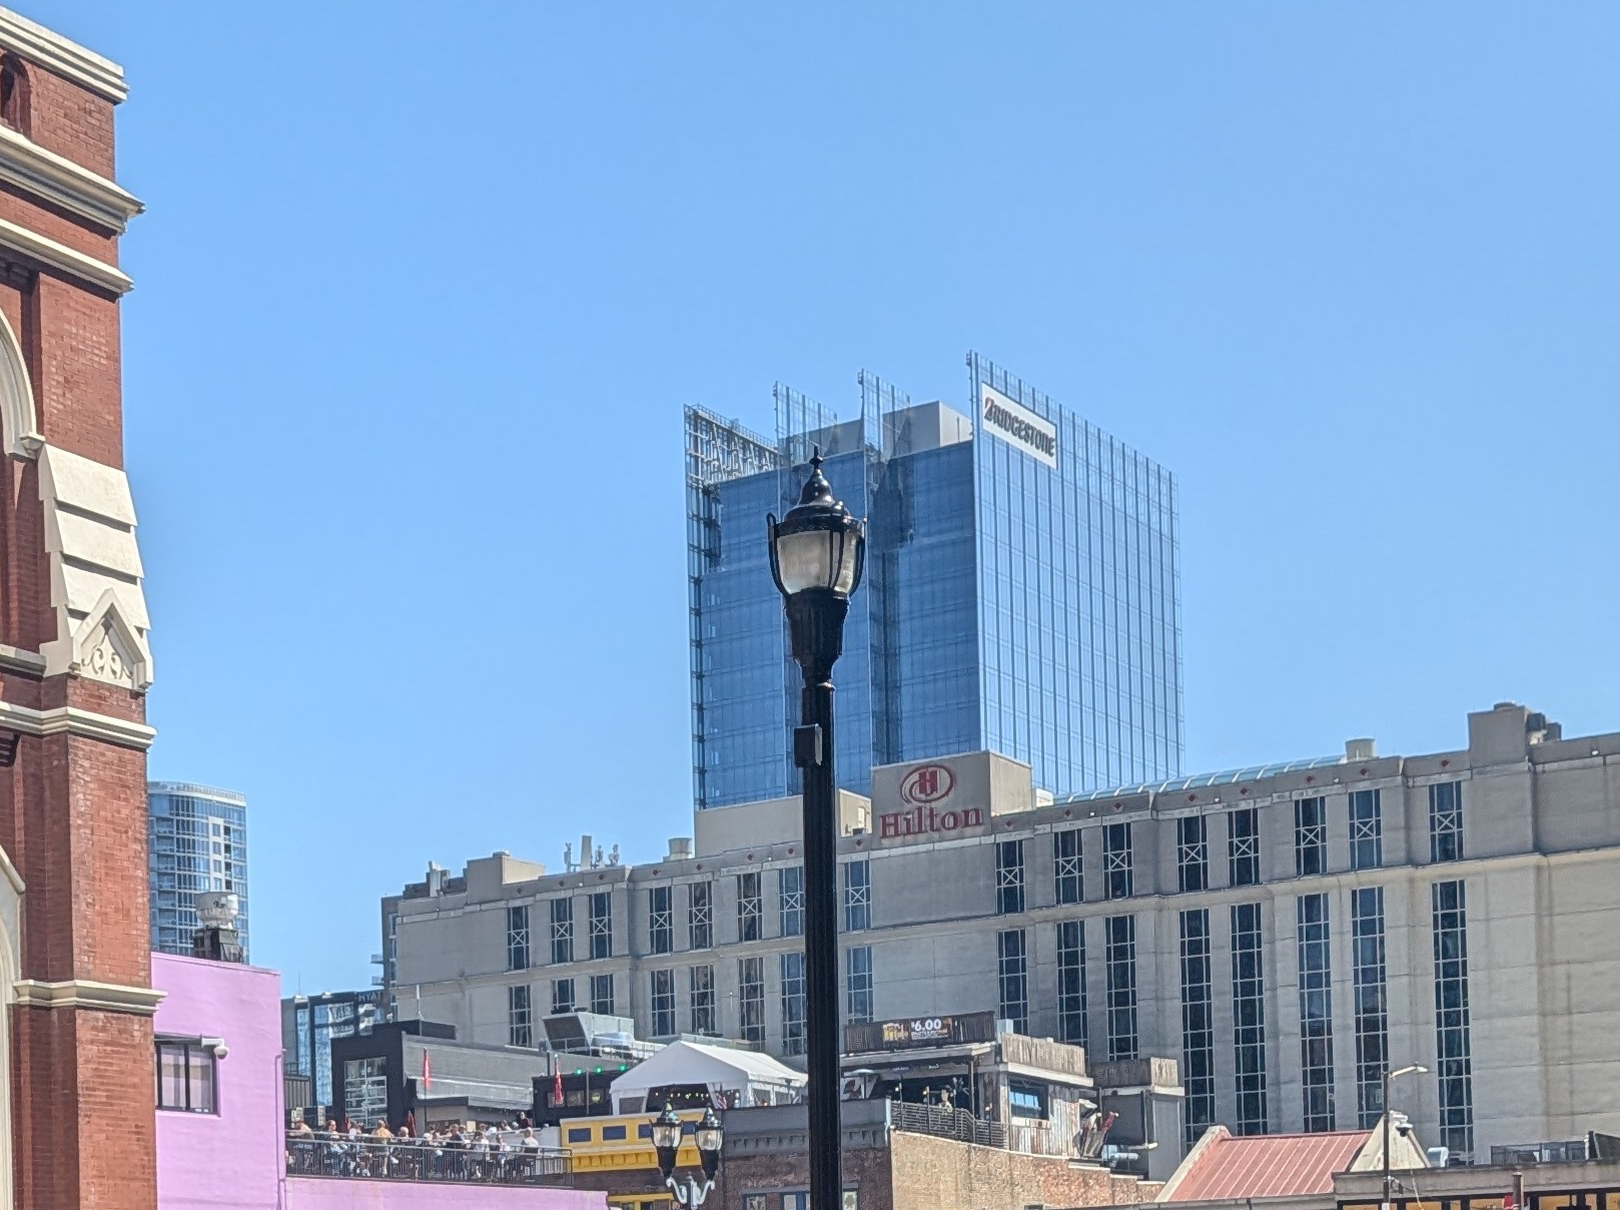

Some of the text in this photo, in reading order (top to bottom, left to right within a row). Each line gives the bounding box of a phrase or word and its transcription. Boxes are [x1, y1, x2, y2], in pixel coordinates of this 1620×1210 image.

[984, 396, 1056, 458] BRIDGESTONE
[880, 806, 983, 839] Hilton
[911, 1018, 942, 1032] $6.00
